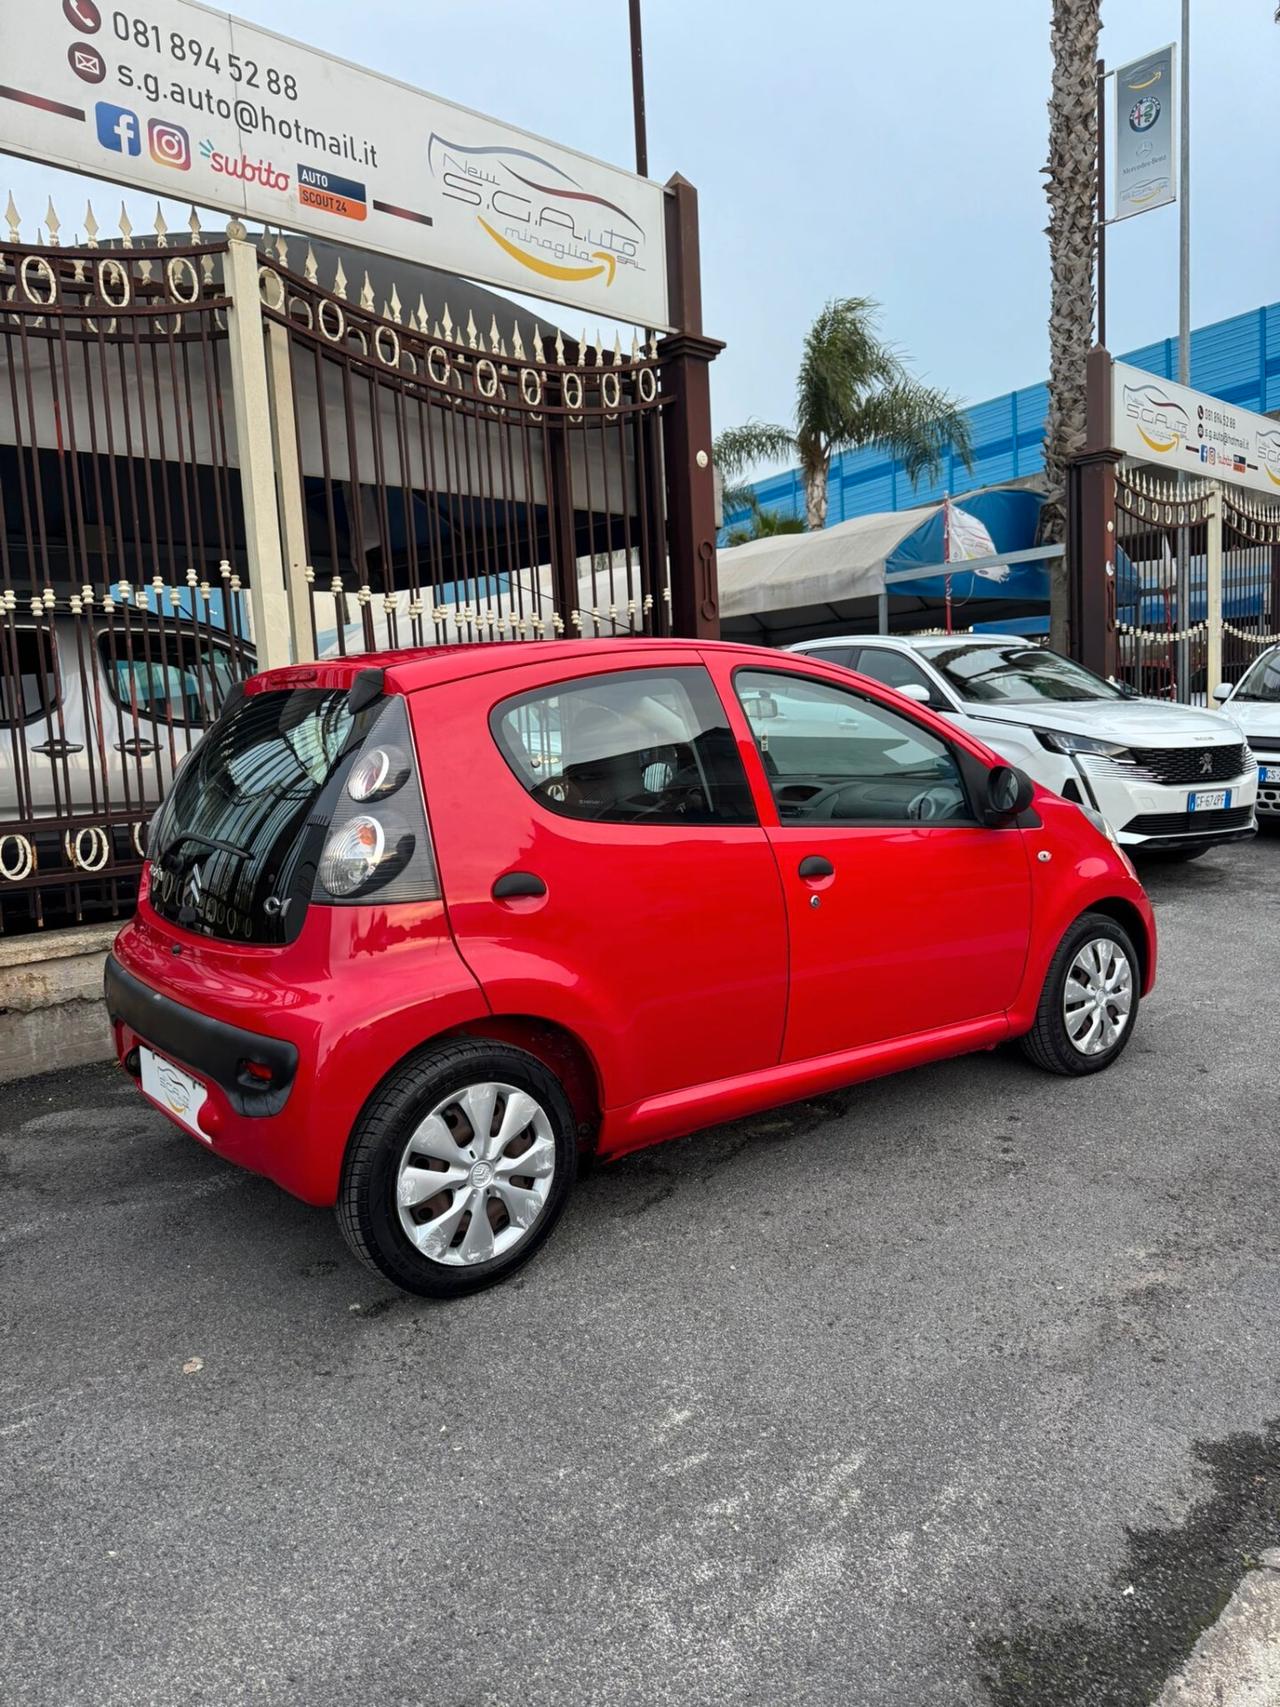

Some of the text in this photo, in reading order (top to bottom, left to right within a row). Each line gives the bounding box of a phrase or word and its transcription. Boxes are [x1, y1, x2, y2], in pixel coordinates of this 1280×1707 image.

[112, 11, 298, 101] 081 894 52 88
[117, 64, 379, 168] s.g.auto@hotmail.it
[210, 151, 291, 192] subito
[300, 169, 329, 188] AUTO
[442, 153, 500, 187] New
[302, 189, 348, 214] SCOUT 24
